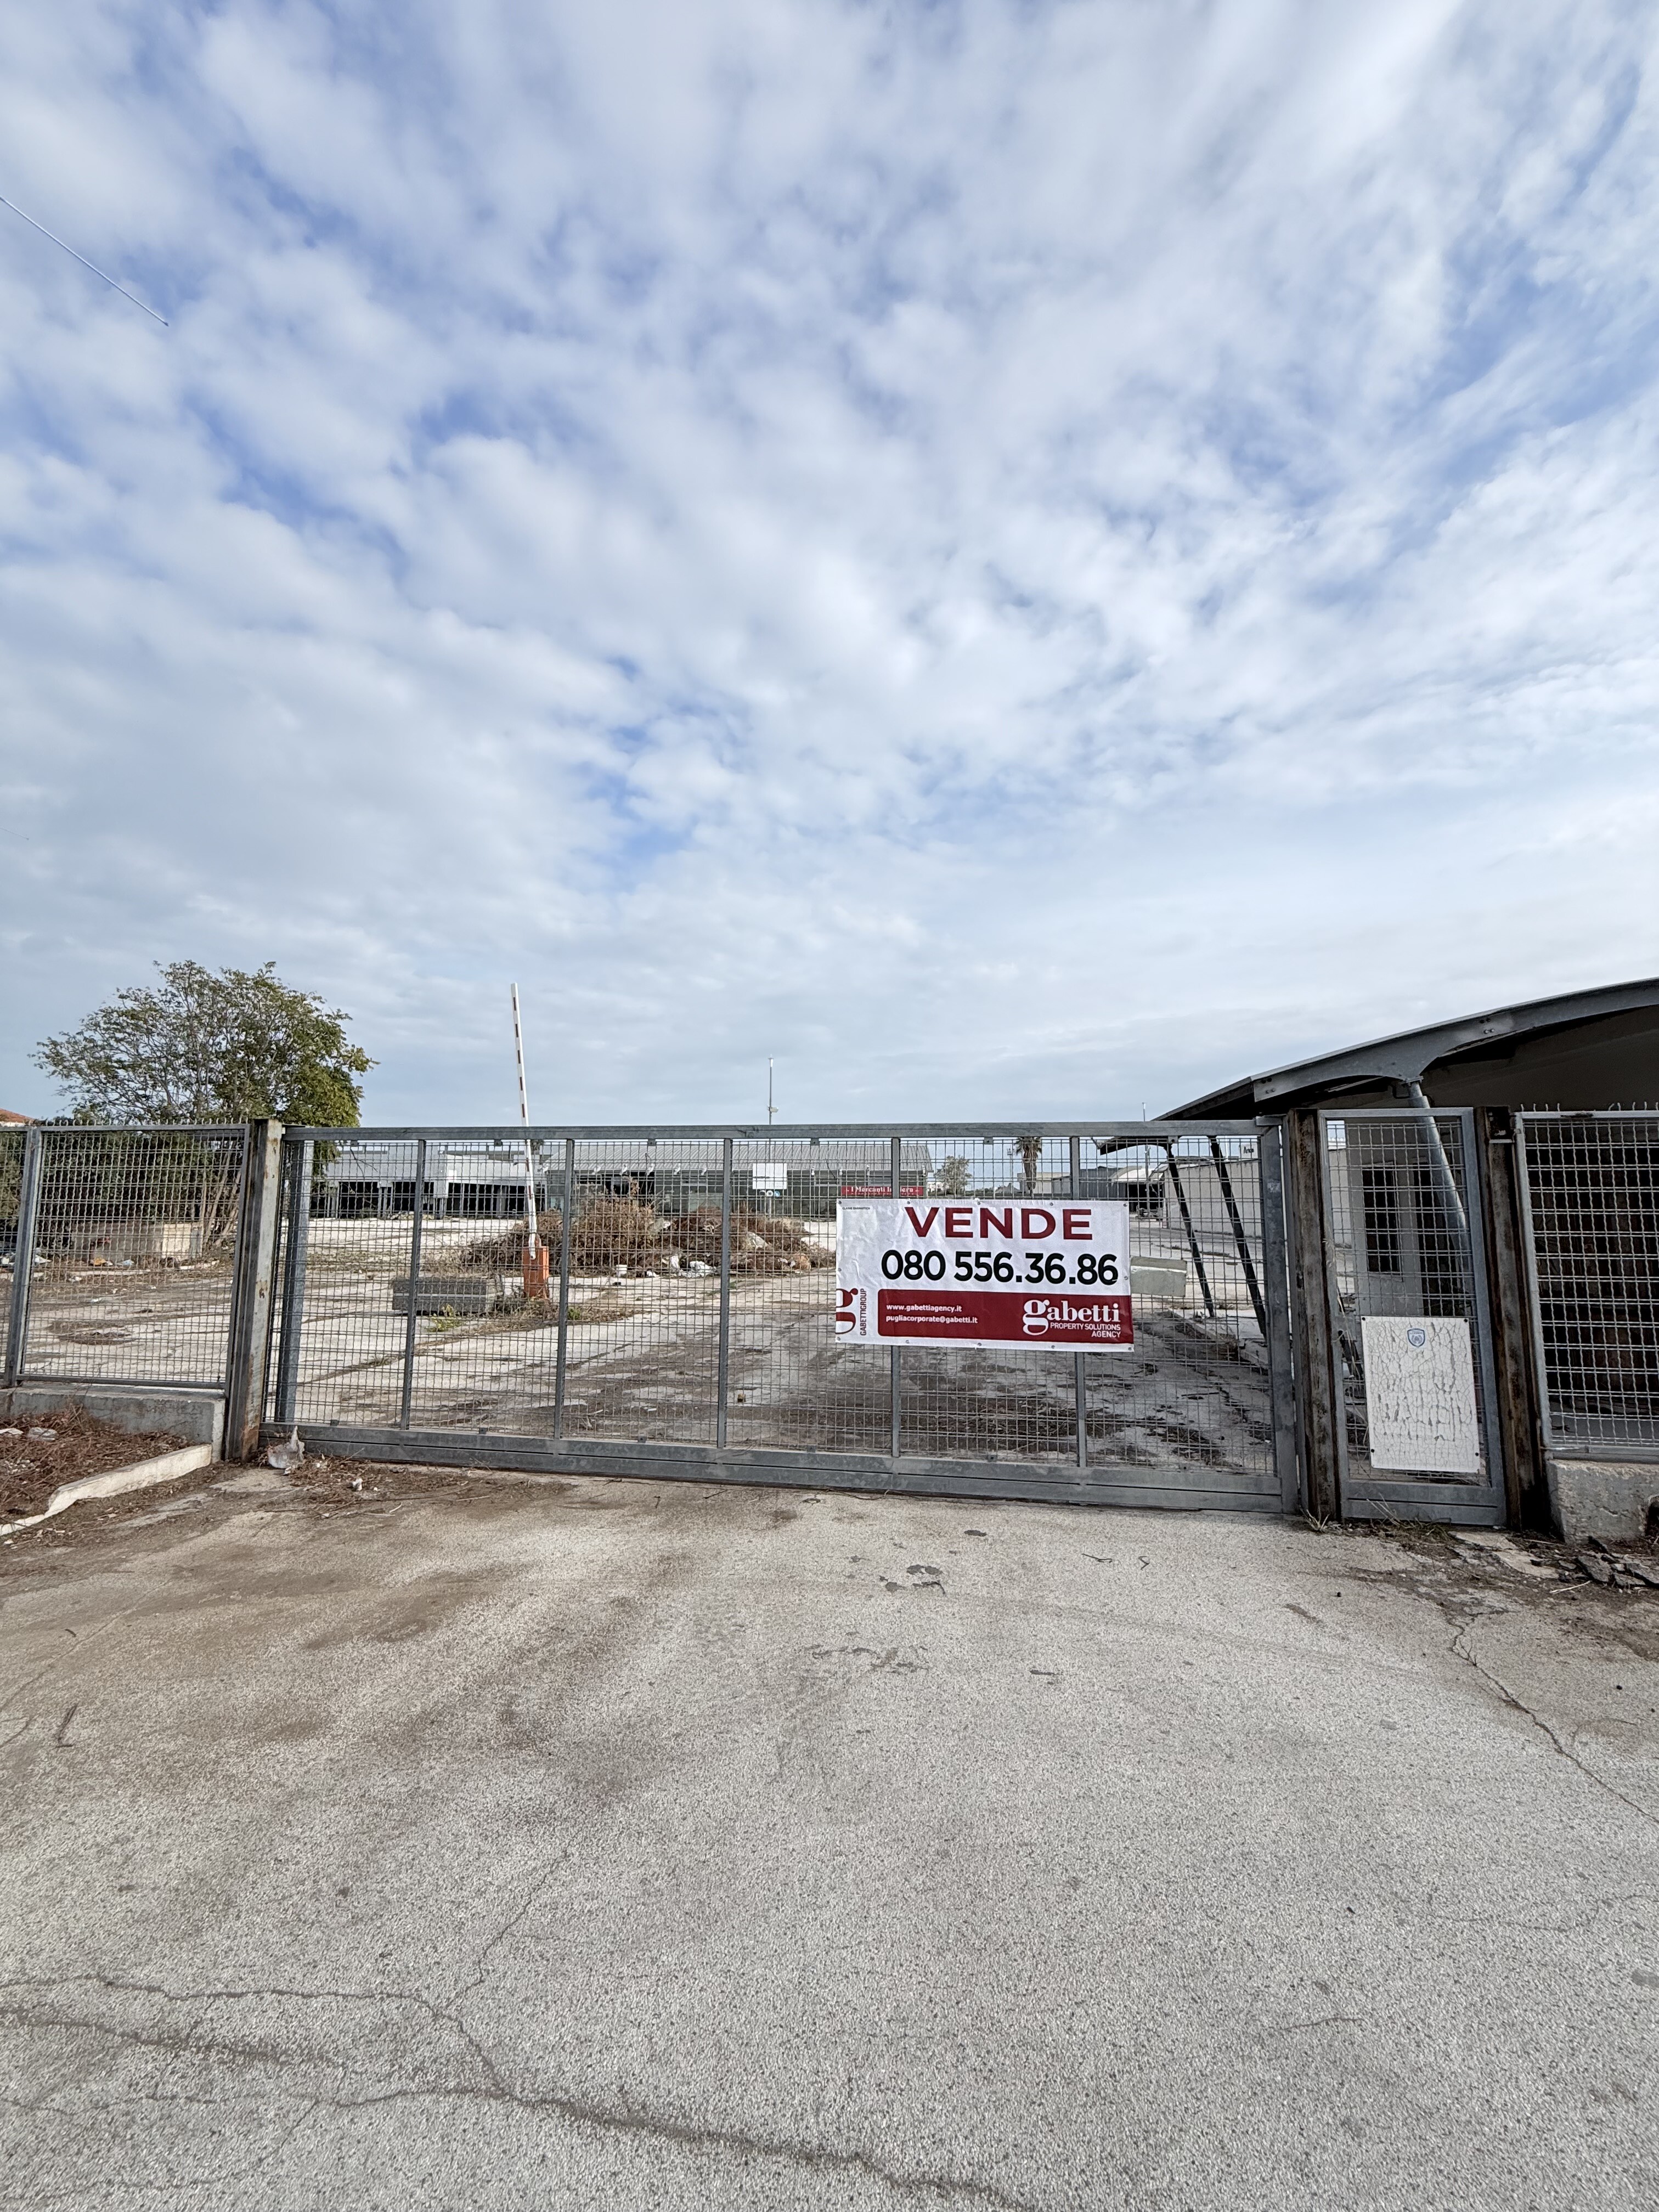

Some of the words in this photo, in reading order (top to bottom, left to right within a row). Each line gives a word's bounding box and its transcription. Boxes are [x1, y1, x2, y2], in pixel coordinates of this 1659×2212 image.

[905, 1206, 1093, 1240] VENDE
[881, 1250, 946, 1280] 080
[953, 1251, 1119, 1285] 556.36.86
[885, 1314, 978, 1324] pugliacorporate@gabetti.it
[886, 1304, 962, 1313] www.gabettiagency.it
[1022, 1299, 1121, 1336] gabetti
[1050, 1322, 1084, 1330] PROPERTY
[1085, 1323, 1121, 1331] SOLUTIONS
